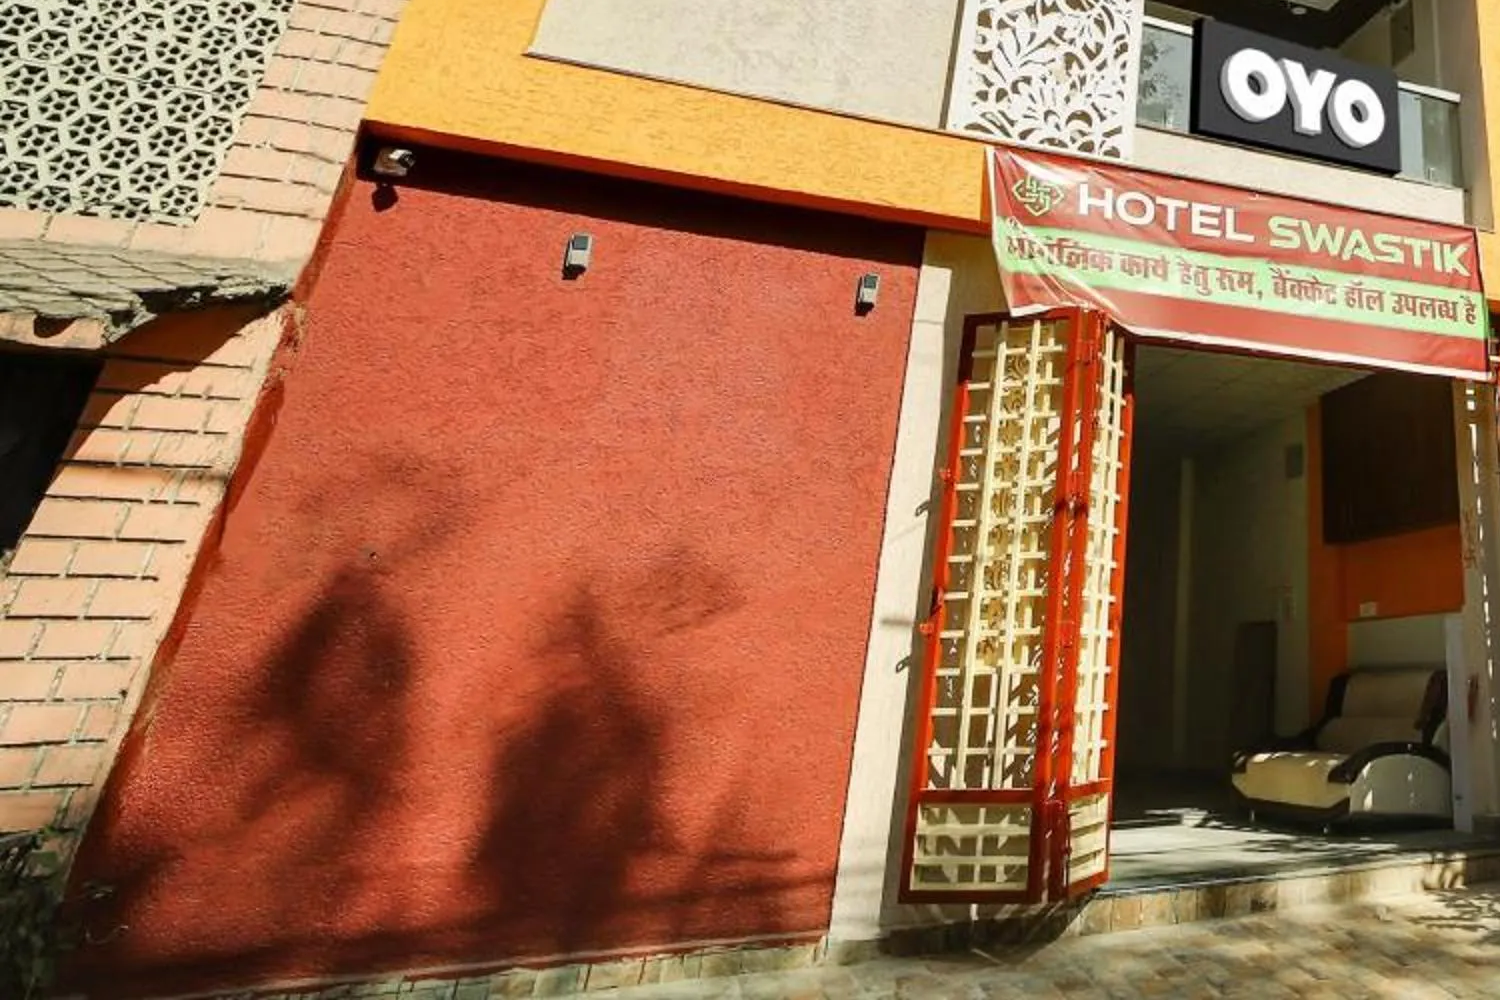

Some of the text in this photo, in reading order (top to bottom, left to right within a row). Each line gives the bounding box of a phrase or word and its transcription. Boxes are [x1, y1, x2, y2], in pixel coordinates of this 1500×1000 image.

[1221, 47, 1386, 149] OYO
[1079, 181, 1472, 277] HOTEL SWASTIK
[1177, 256, 1212, 296] हेतु
[1344, 280, 1384, 312] हॉल
[1390, 292, 1458, 323] उपलब्ध
[1460, 295, 1476, 325] है
